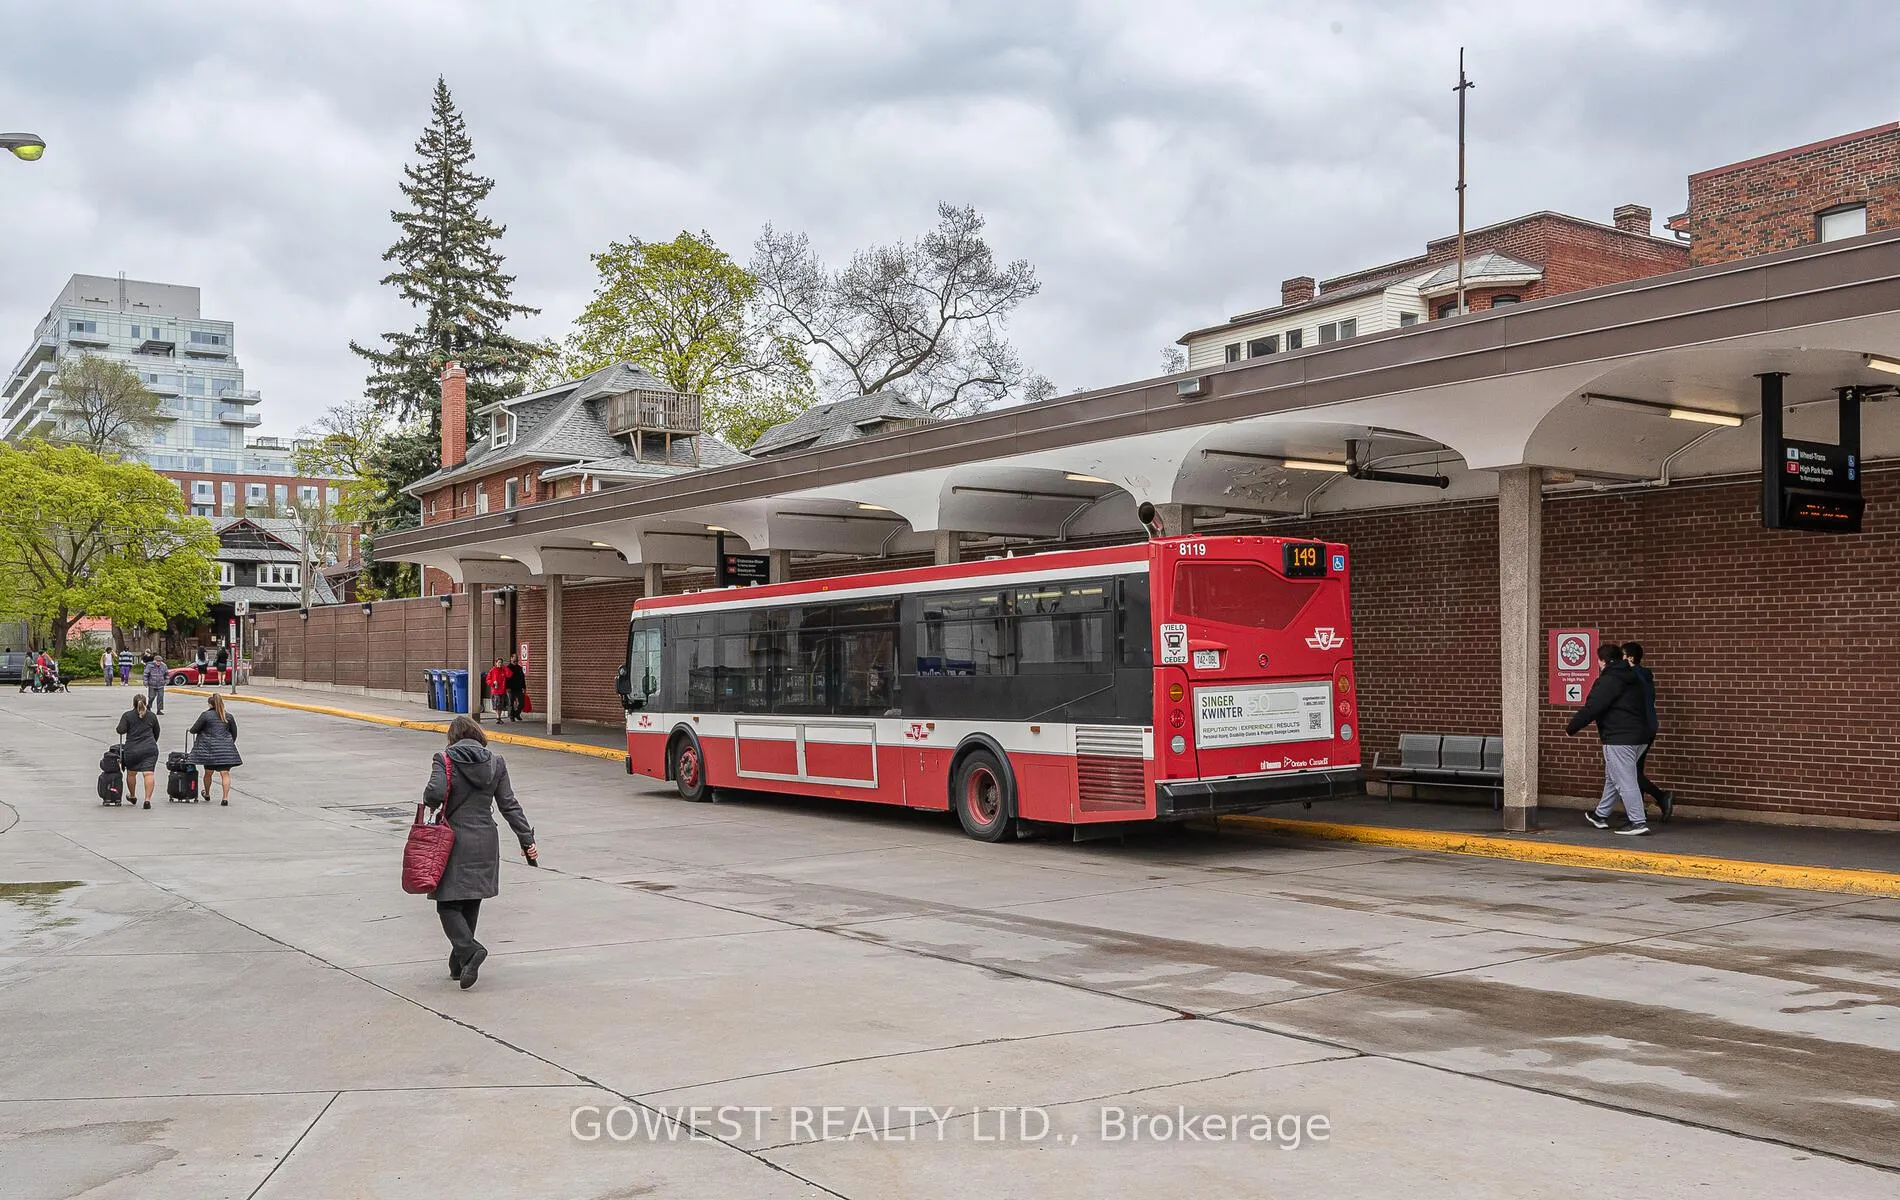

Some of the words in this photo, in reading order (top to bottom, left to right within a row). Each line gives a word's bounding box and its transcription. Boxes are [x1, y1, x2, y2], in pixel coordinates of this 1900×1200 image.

[1800, 465, 1810, 474] High
[1821, 468, 1833, 476] North
[1180, 544, 1206, 556] 8119
[1294, 548, 1316, 566] 149
[1202, 696, 1234, 707] SINGER
[1202, 706, 1242, 719] KWINTER
